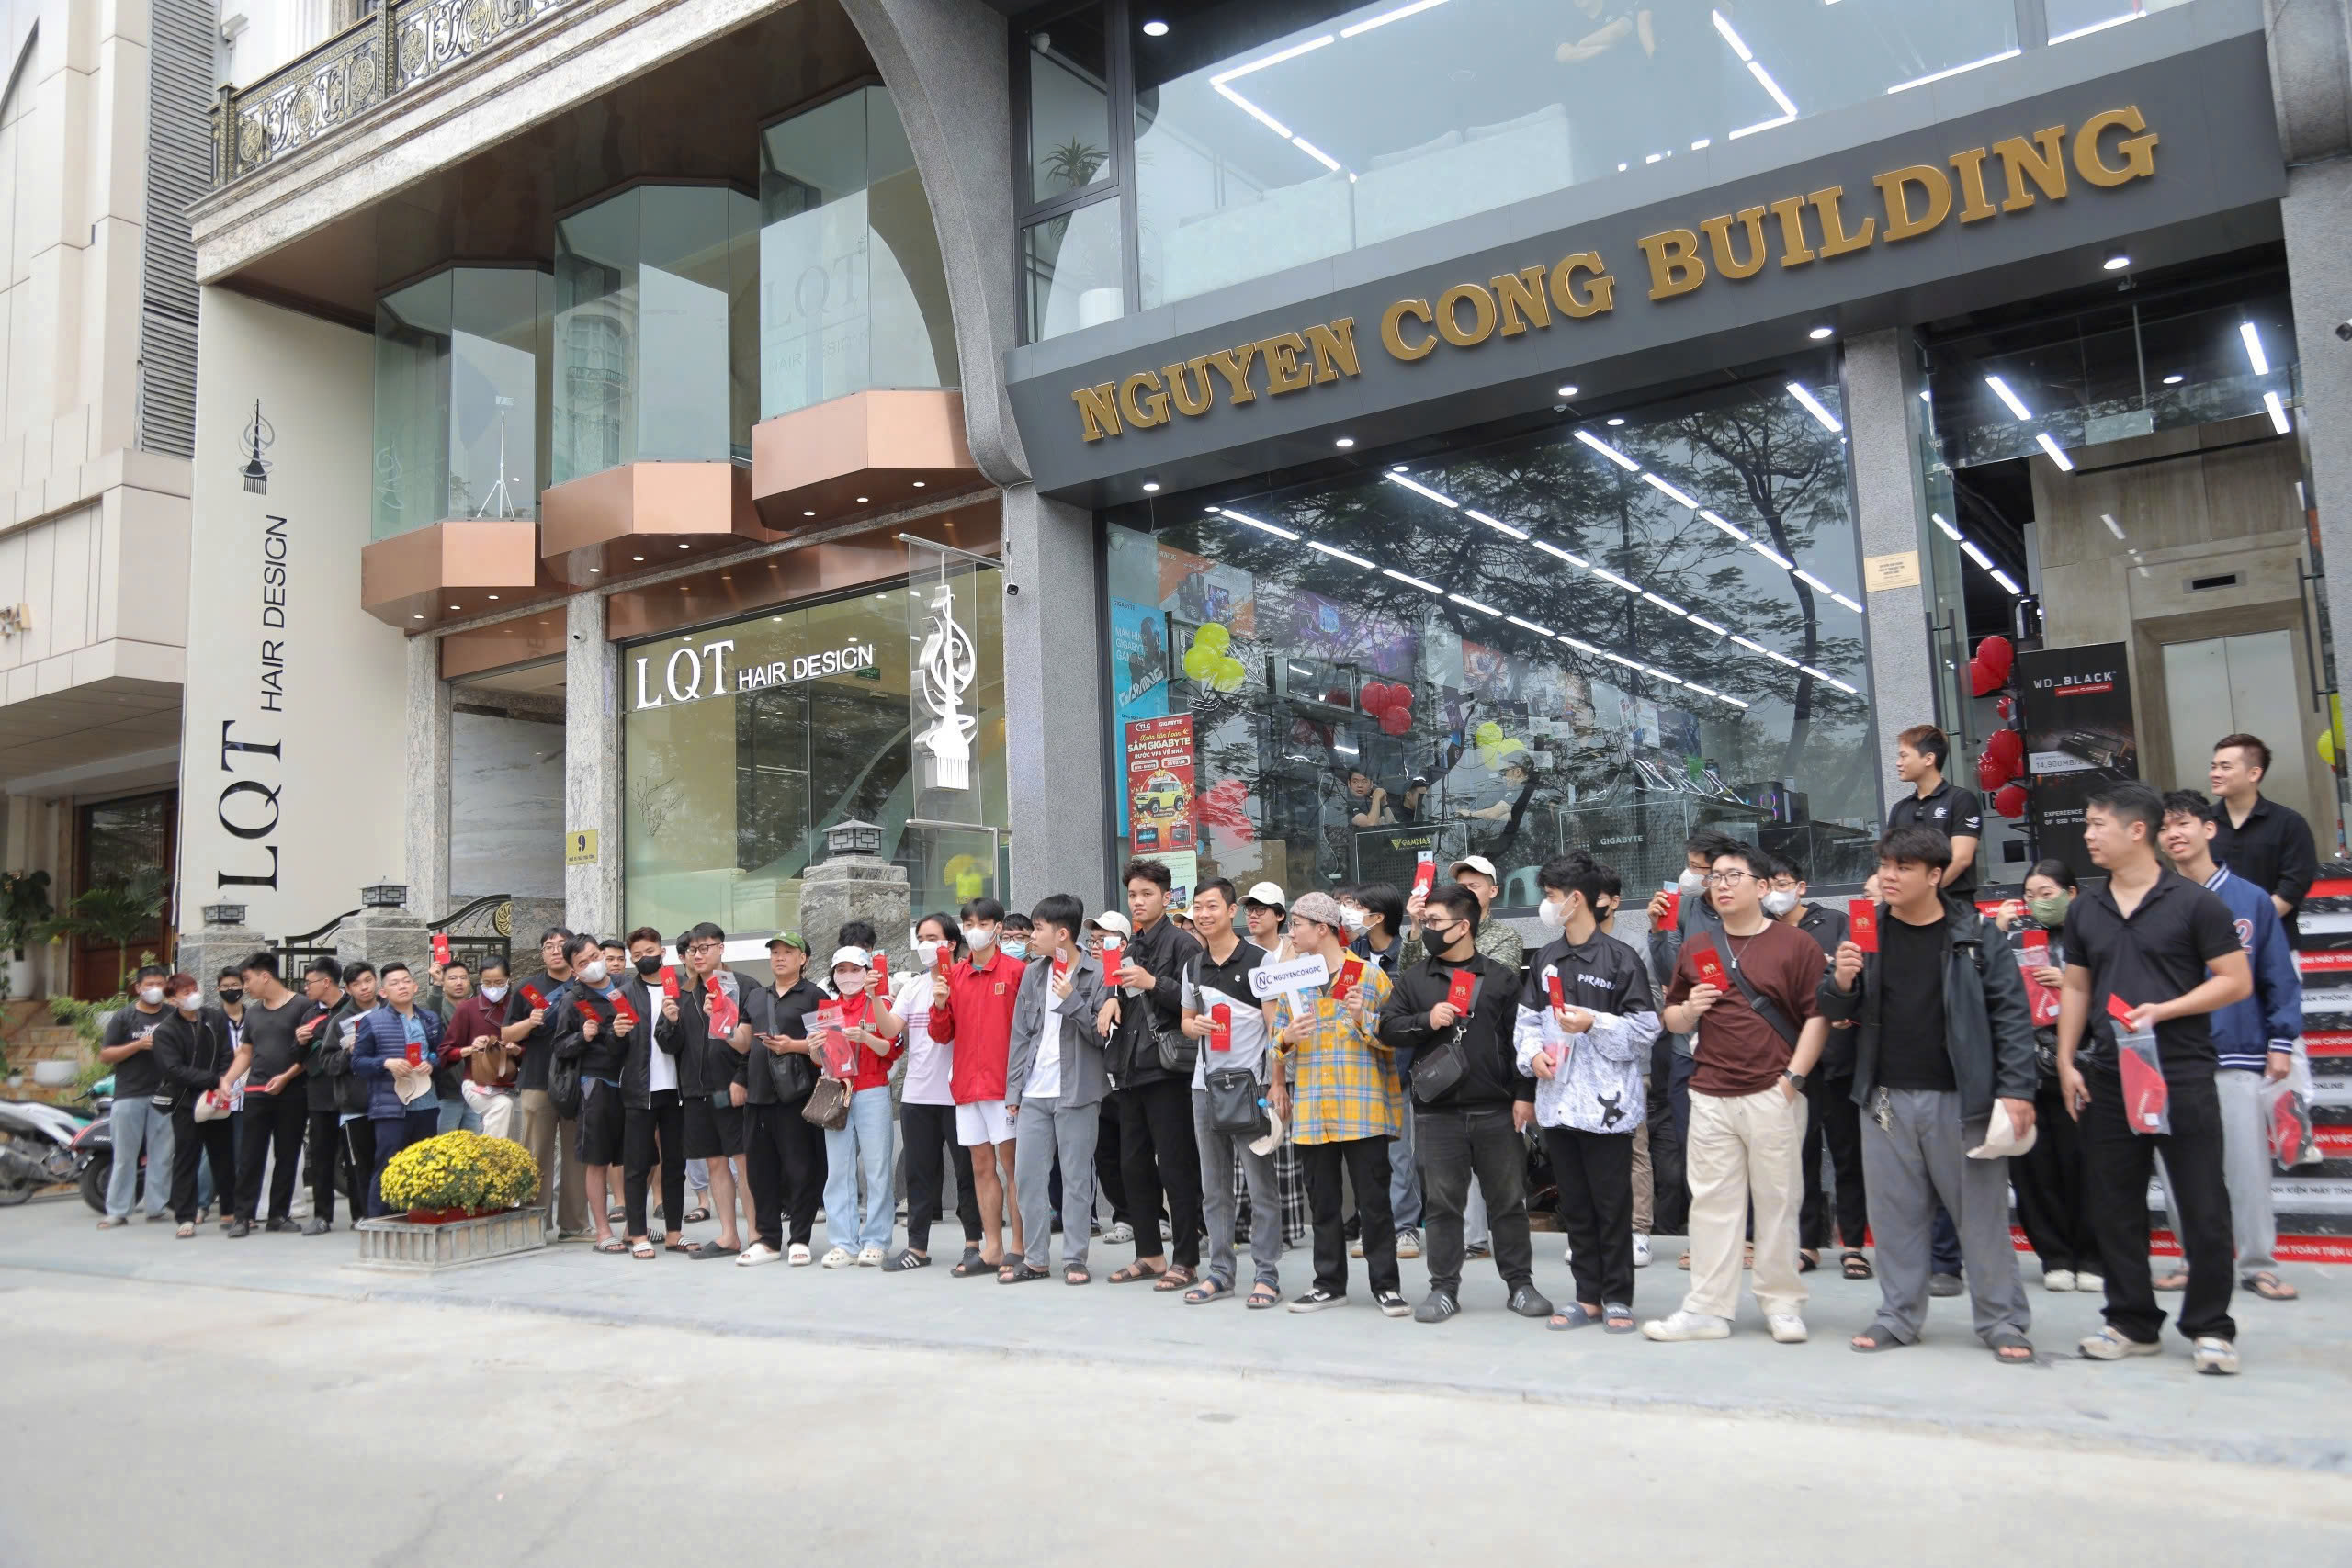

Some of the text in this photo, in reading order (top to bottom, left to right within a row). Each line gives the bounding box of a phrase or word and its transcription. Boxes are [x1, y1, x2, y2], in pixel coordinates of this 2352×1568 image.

[1070, 105, 2159, 444] NGUYEN CONG BUILDING
[1113, 600, 1136, 611] GIGABYTE
[636, 639, 874, 710] LQT HAIR DESIGN
[217, 514, 288, 892] LQT HAIR DESIGN
[1148, 737, 1191, 750] GIGABYTE
[2044, 808, 2084, 818] EXPERIENCE
[578, 834, 586, 852] 9
[1600, 835, 1643, 845] GIGABYTE
[1273, 965, 1322, 982] NGUYENCONGPC
